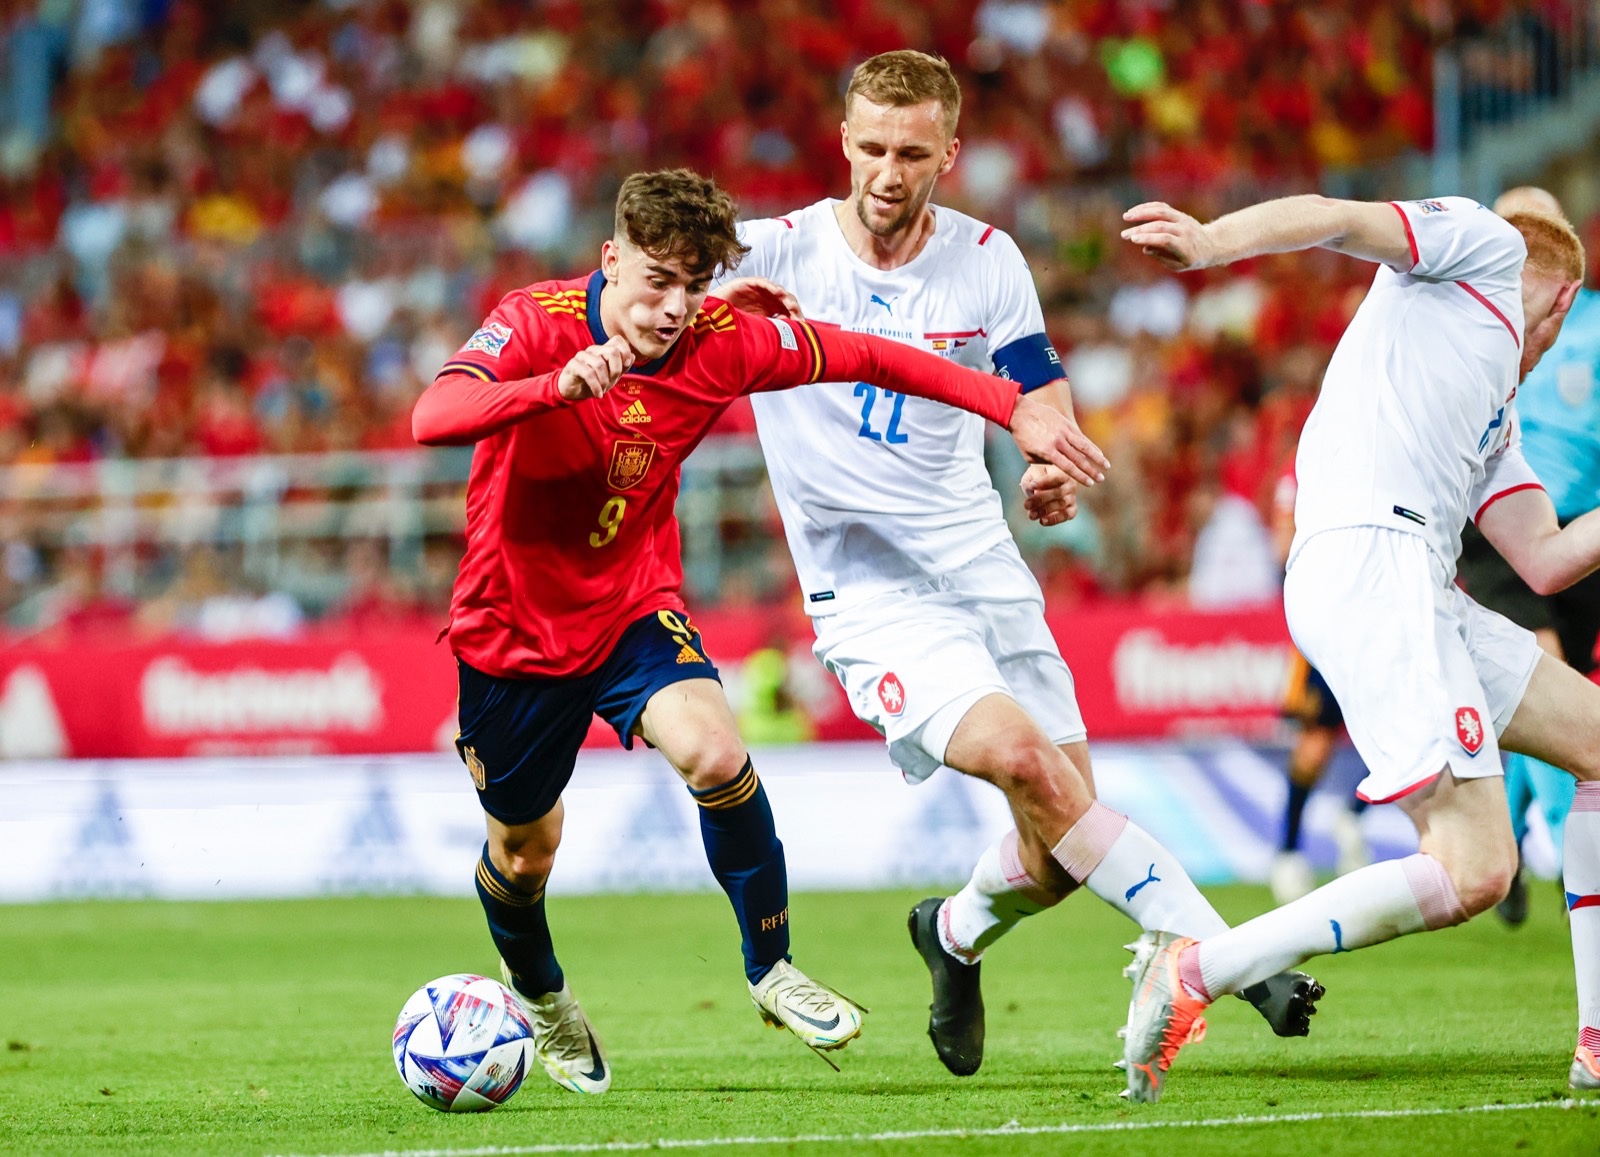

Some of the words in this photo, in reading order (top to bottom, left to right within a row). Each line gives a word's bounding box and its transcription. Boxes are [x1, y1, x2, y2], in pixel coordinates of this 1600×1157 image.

[879, 328, 914, 339] REPUBLIC
[619, 414, 652, 425] adidas
[853, 381, 909, 444] 22
[589, 496, 627, 548] 9
[657, 610, 693, 646] 9
